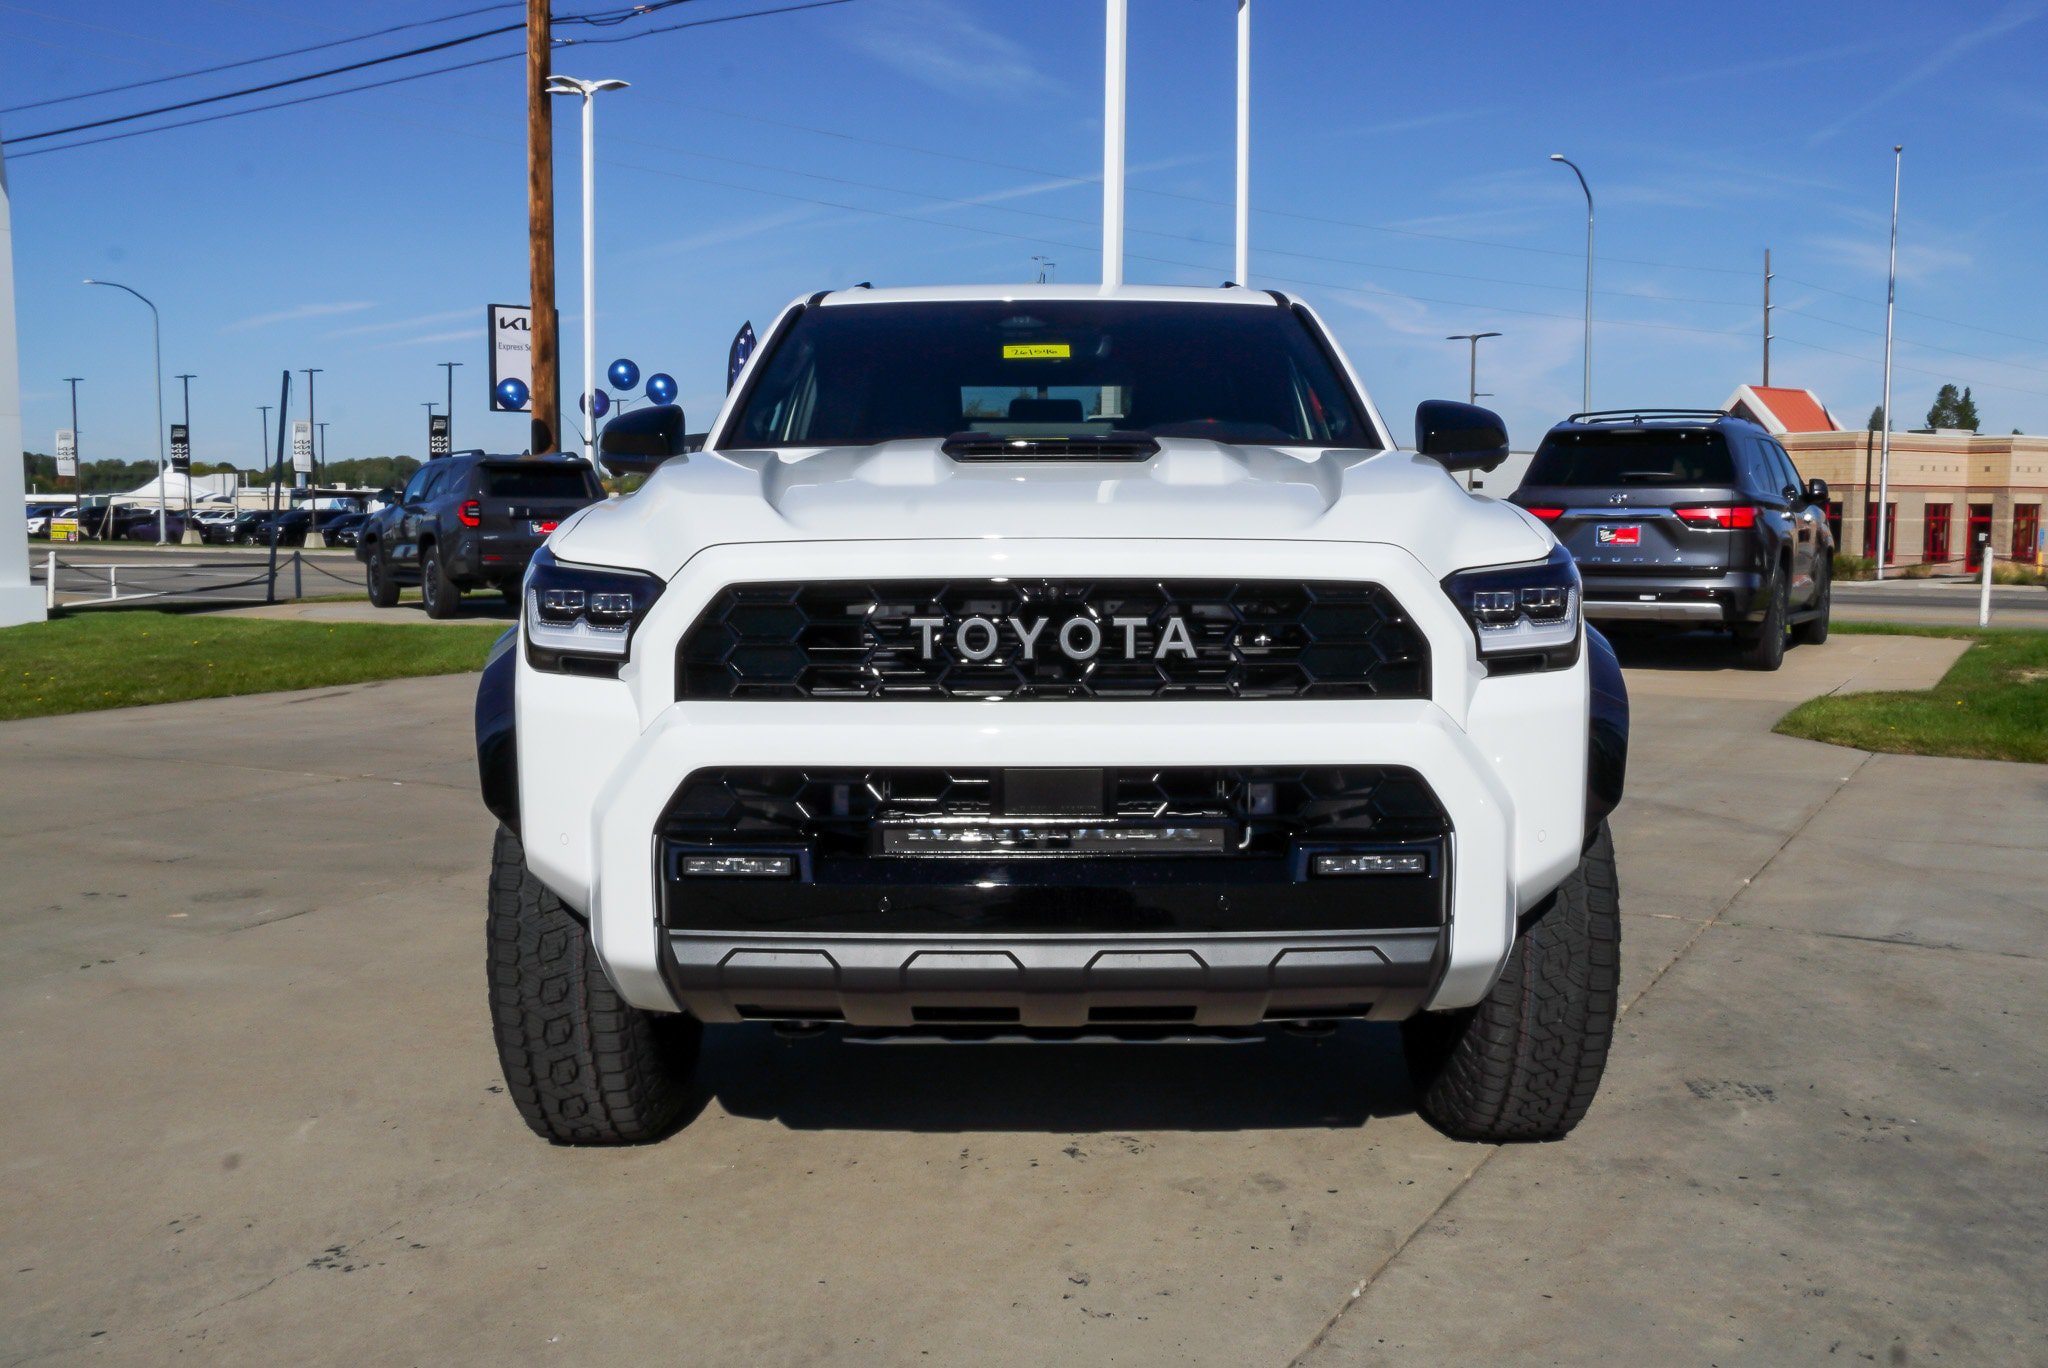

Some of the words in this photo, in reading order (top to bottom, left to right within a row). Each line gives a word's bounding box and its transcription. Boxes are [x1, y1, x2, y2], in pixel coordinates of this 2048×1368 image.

[500, 317, 531, 330] KI
[498, 342, 523, 351] Express
[910, 617, 1198, 660] TOYOTA
